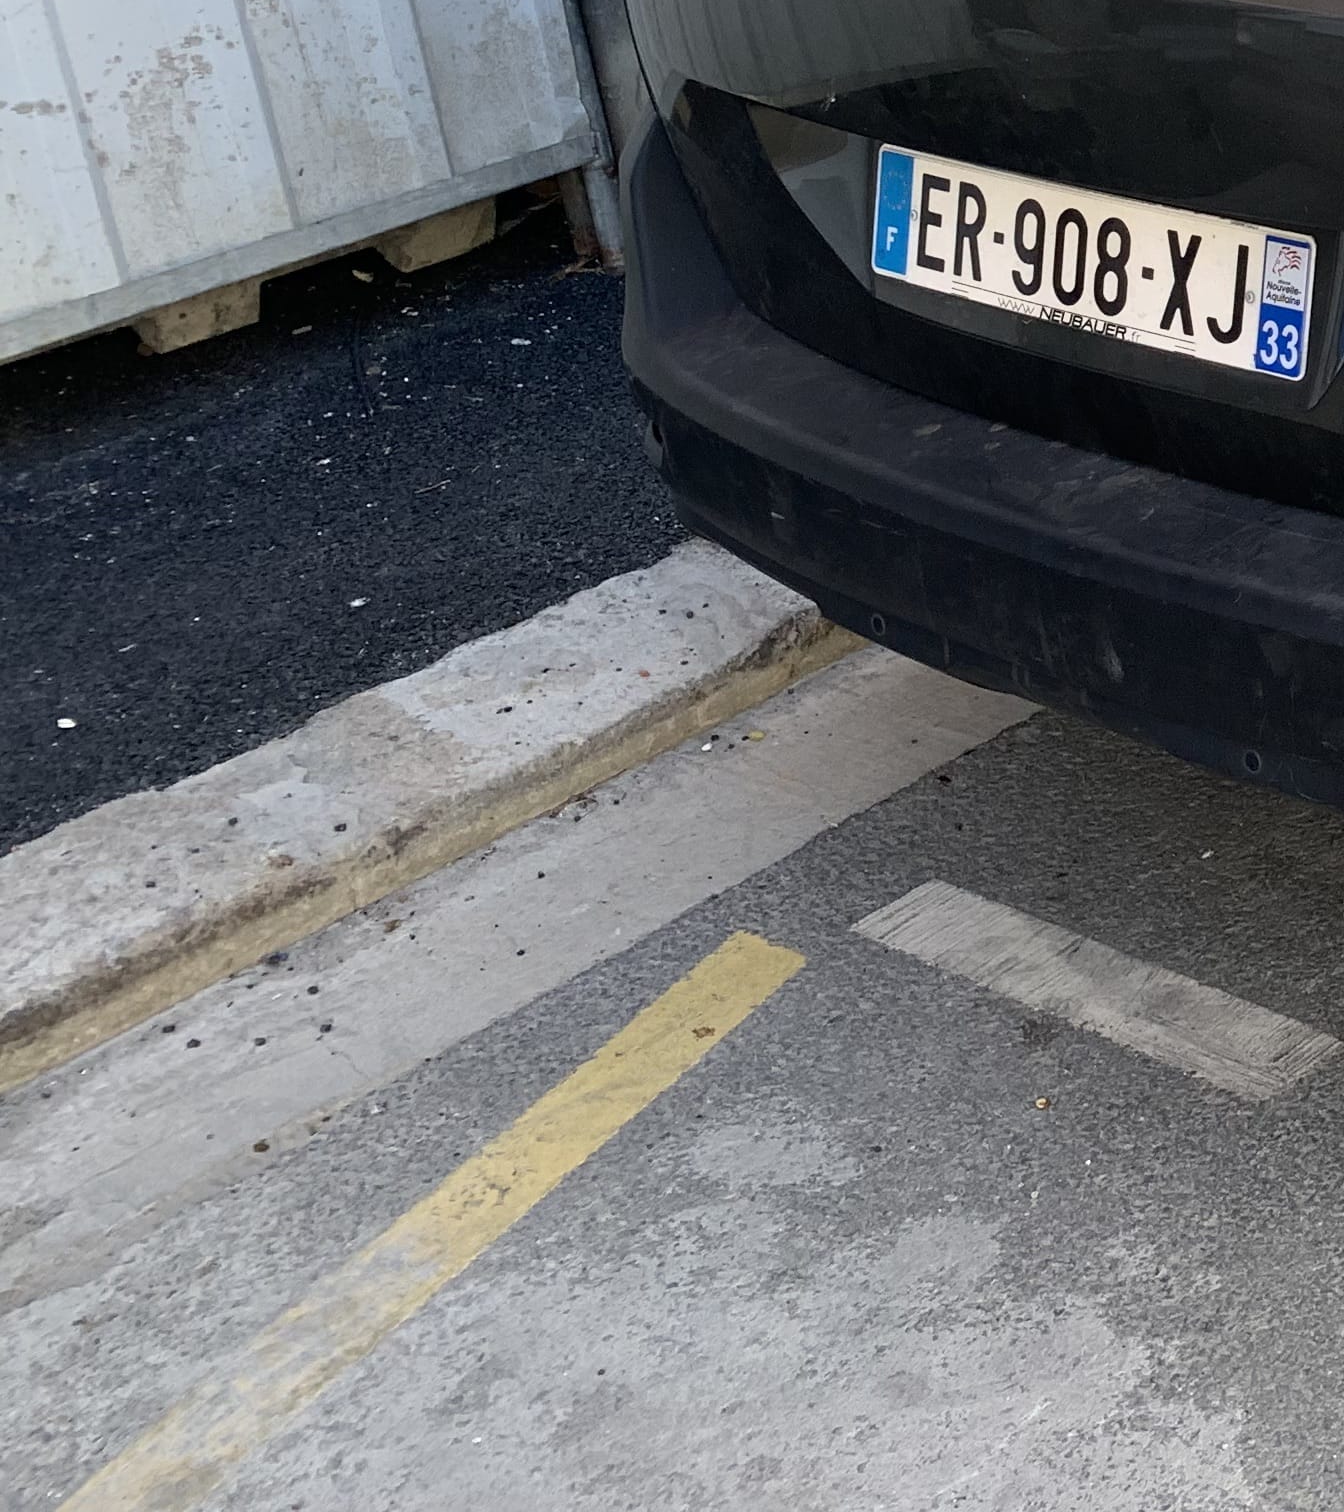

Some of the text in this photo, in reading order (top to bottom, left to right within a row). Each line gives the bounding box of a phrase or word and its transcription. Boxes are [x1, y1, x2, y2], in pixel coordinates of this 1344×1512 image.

[886, 226, 898, 252] F
[917, 173, 1250, 345] ER-908-XJ
[1265, 291, 1301, 306] Aquitaine
[1039, 305, 1128, 340] NEUBAUER
[1259, 319, 1299, 370] 33
